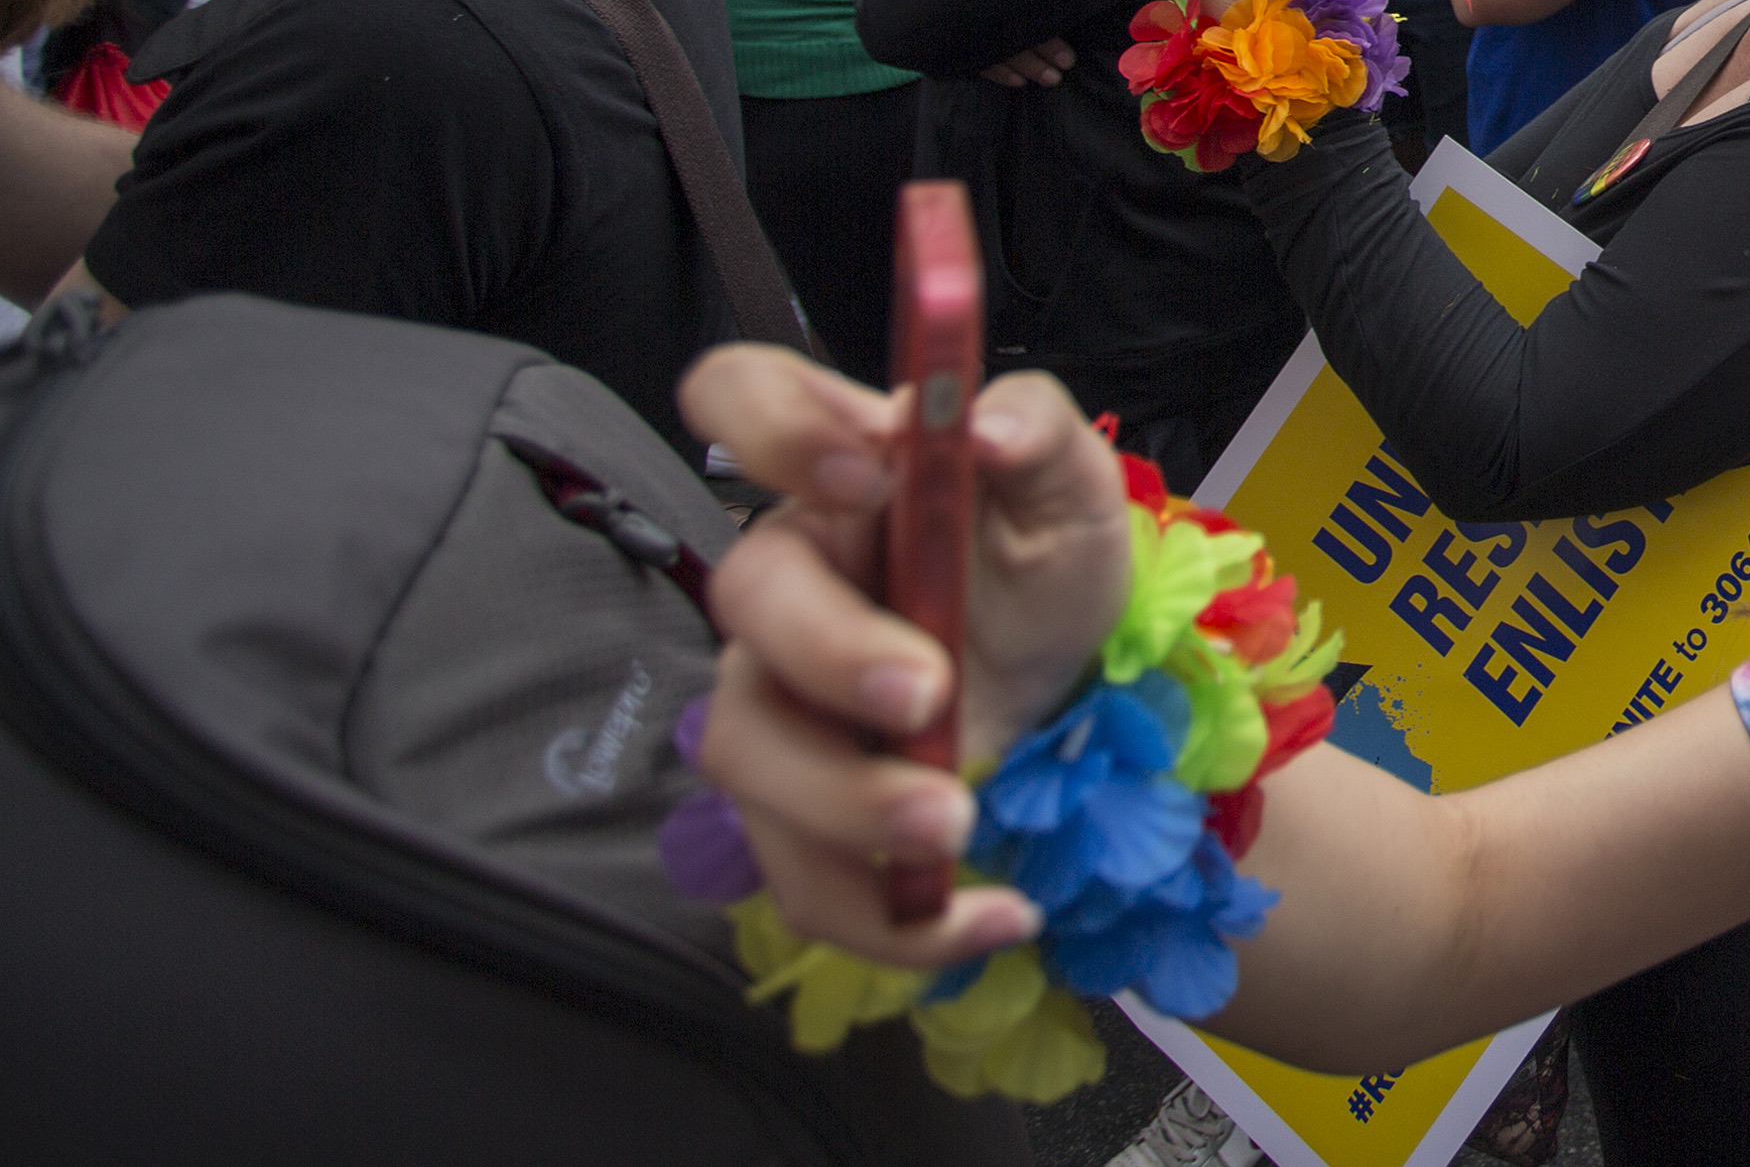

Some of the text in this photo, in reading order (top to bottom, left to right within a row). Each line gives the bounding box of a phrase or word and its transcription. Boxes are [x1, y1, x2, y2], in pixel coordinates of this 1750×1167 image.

[1604, 657, 1684, 741] NITE
[1672, 627, 1708, 662] to
[1346, 1067, 1406, 1125] #R
